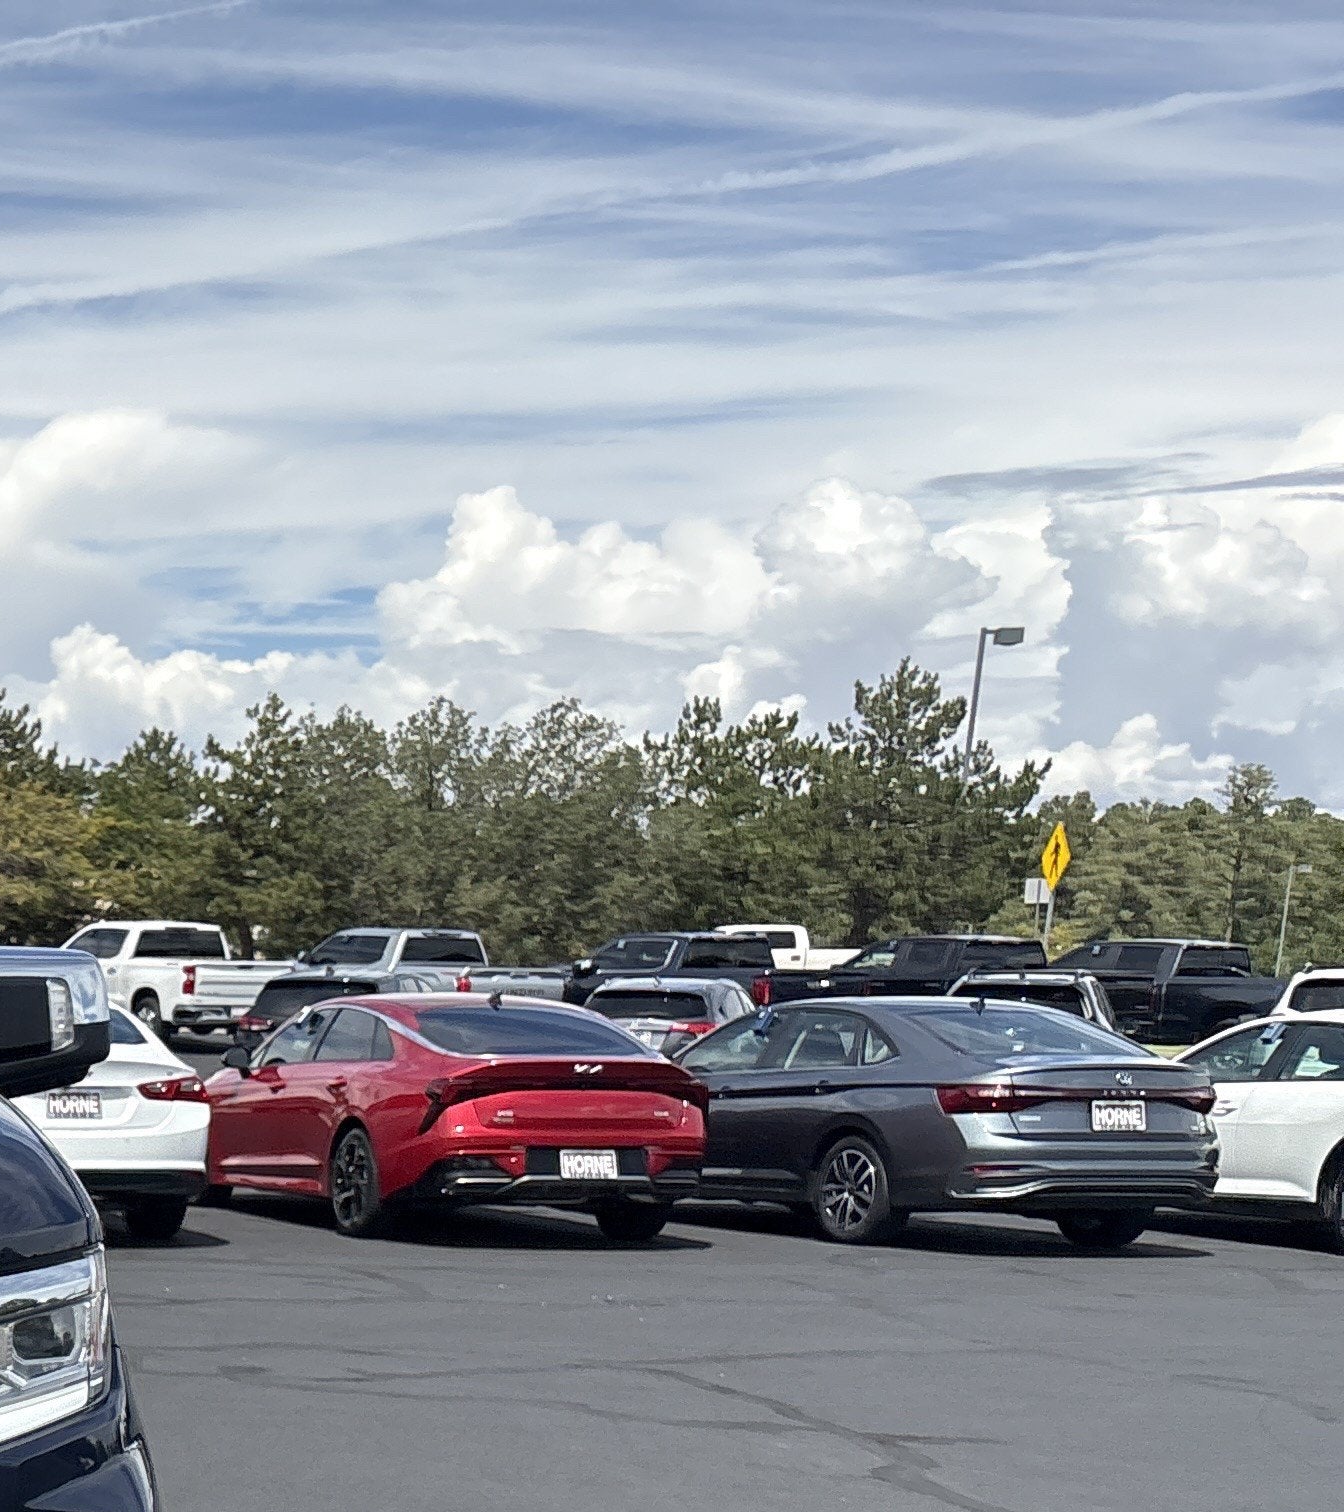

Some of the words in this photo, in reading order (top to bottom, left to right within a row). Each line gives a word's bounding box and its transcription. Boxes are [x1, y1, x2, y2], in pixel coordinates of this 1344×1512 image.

[49, 1094, 99, 1114] HORNE
[1095, 1106, 1142, 1126] HORNE
[563, 1154, 614, 1175] HORNE
